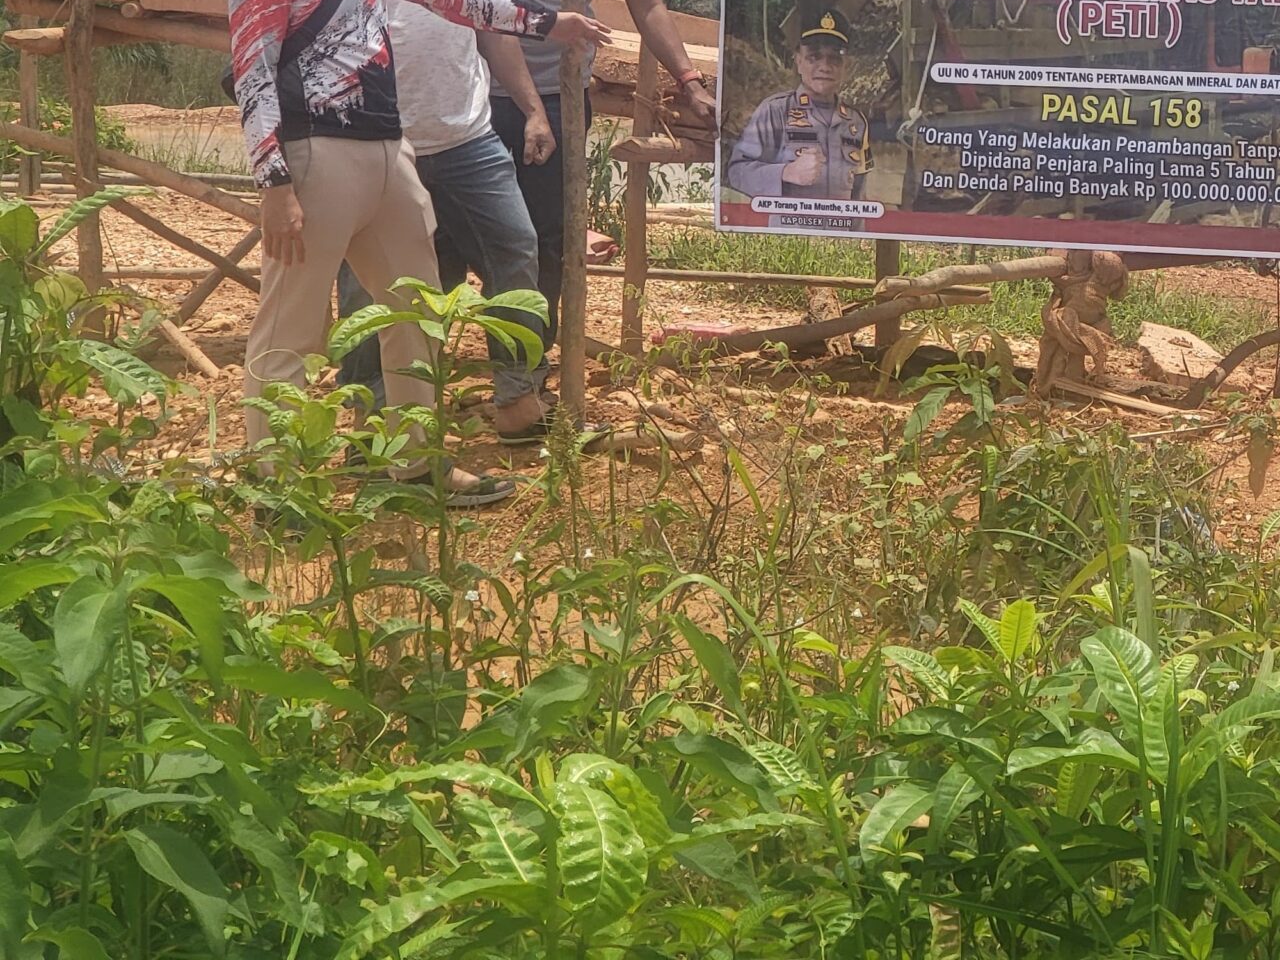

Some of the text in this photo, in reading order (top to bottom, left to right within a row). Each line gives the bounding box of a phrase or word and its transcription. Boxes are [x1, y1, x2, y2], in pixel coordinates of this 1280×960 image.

[937, 67, 951, 78] UU
[954, 68, 969, 79] NO
[972, 68, 978, 79] 4
[980, 69, 1016, 80] TAHUN
[1018, 70, 1043, 81] 2009
[1046, 71, 1094, 83] TENTANG
[1096, 73, 1184, 87] PERTAMBANGAN
[1186, 76, 1233, 88] MINERAL
[1236, 78, 1258, 89] DAN
[1041, 93, 1202, 128] PASAL 158
[978, 129, 1017, 151] Yang
[1022, 132, 1111, 152] Melakukan
[1116, 136, 1232, 160] Penambangan
[961, 151, 1276, 180] Dipidana Penjara Paling Lama 5 Tahun
[923, 171, 953, 189] Dan
[958, 173, 1008, 191] Denda
[1013, 175, 1064, 197] Paling
[1069, 178, 1128, 199] Banyak
[1134, 181, 1156, 200] Rp
[758, 200, 771, 208] AKP
[774, 201, 798, 211] Torang
[800, 202, 812, 210] Tua
[814, 202, 843, 213] Munthe,
[862, 205, 878, 214] M.H
[781, 217, 852, 227] KAPOLSEK TABIR
